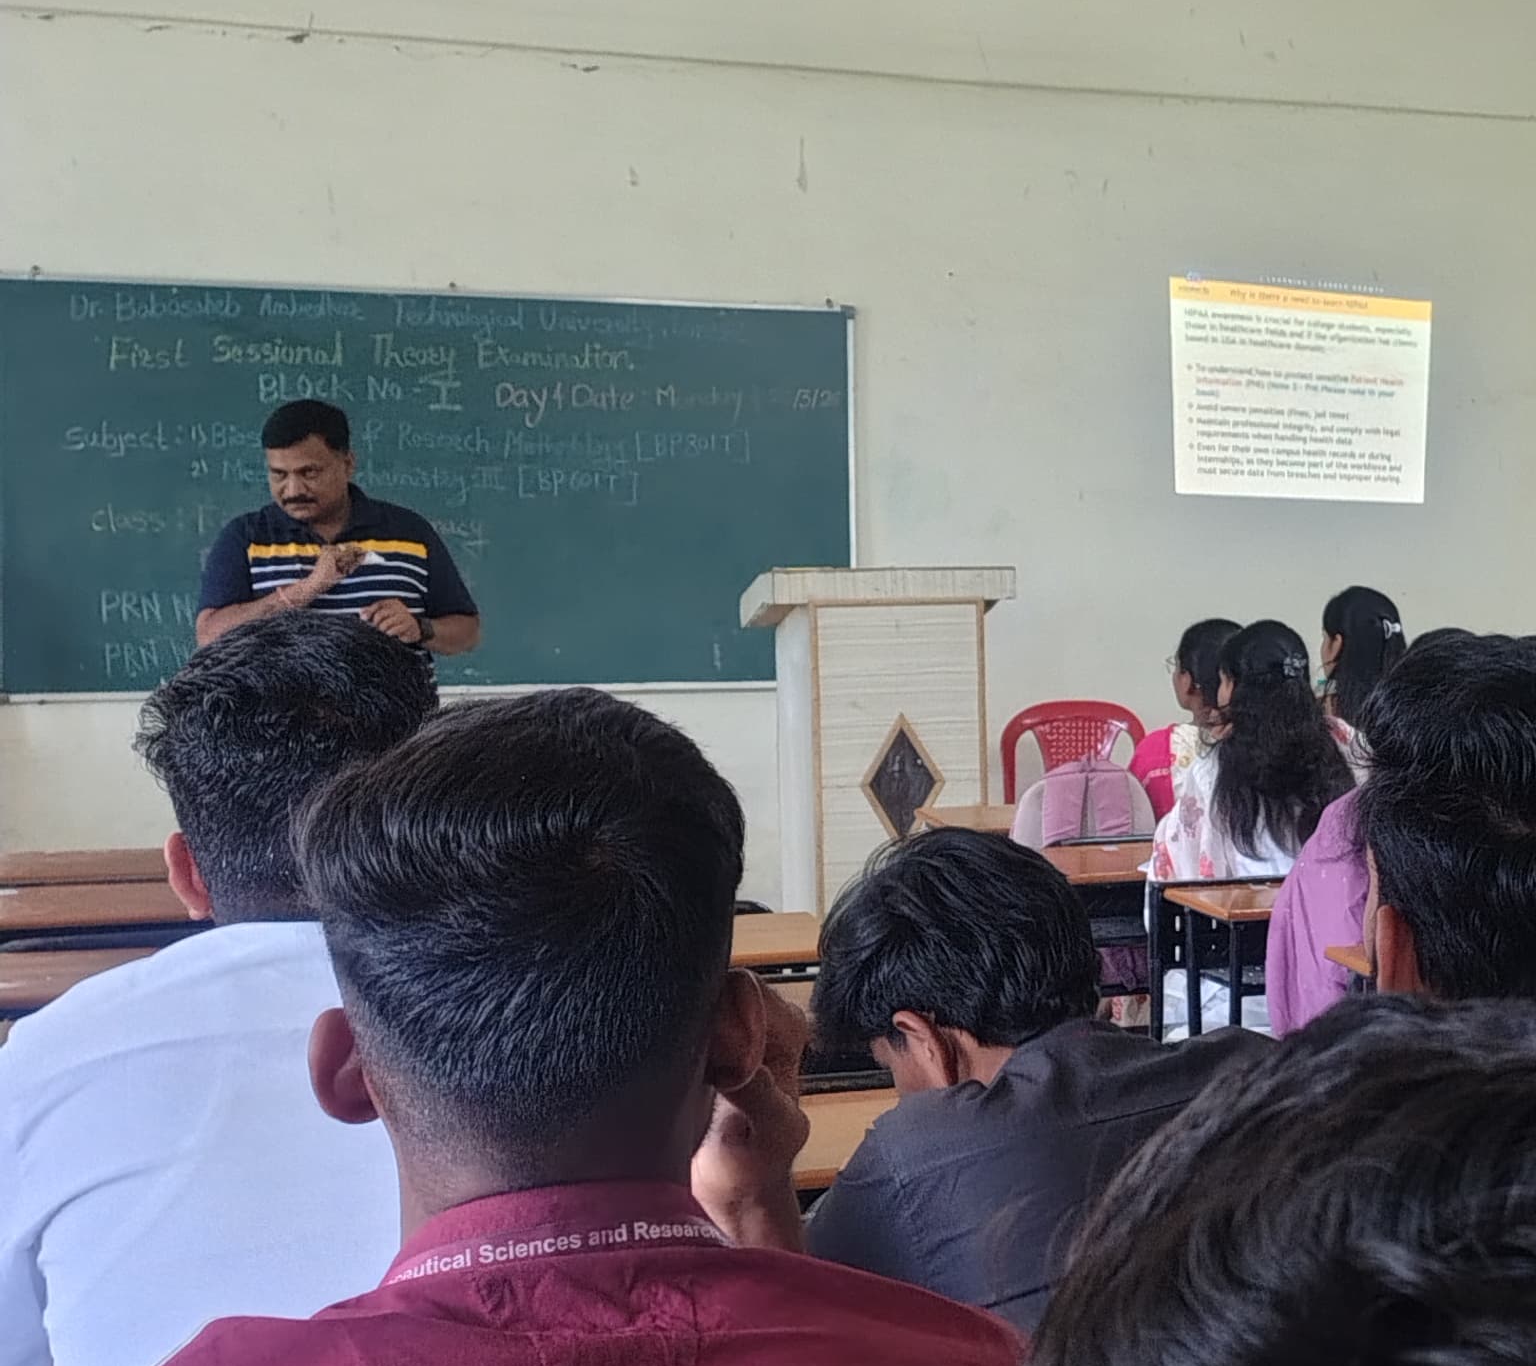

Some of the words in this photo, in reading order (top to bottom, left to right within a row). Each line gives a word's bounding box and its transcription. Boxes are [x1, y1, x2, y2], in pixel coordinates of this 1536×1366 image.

[108, 336, 193, 371] First
[211, 331, 343, 367] Sessional
[369, 332, 456, 379] Theory
[495, 381, 547, 428] Day
[102, 589, 162, 625] PRN
[172, 592, 197, 628] N
[105, 639, 159, 678] PRN
[478, 1232, 582, 1265] Sciences
[588, 1221, 628, 1247] and
